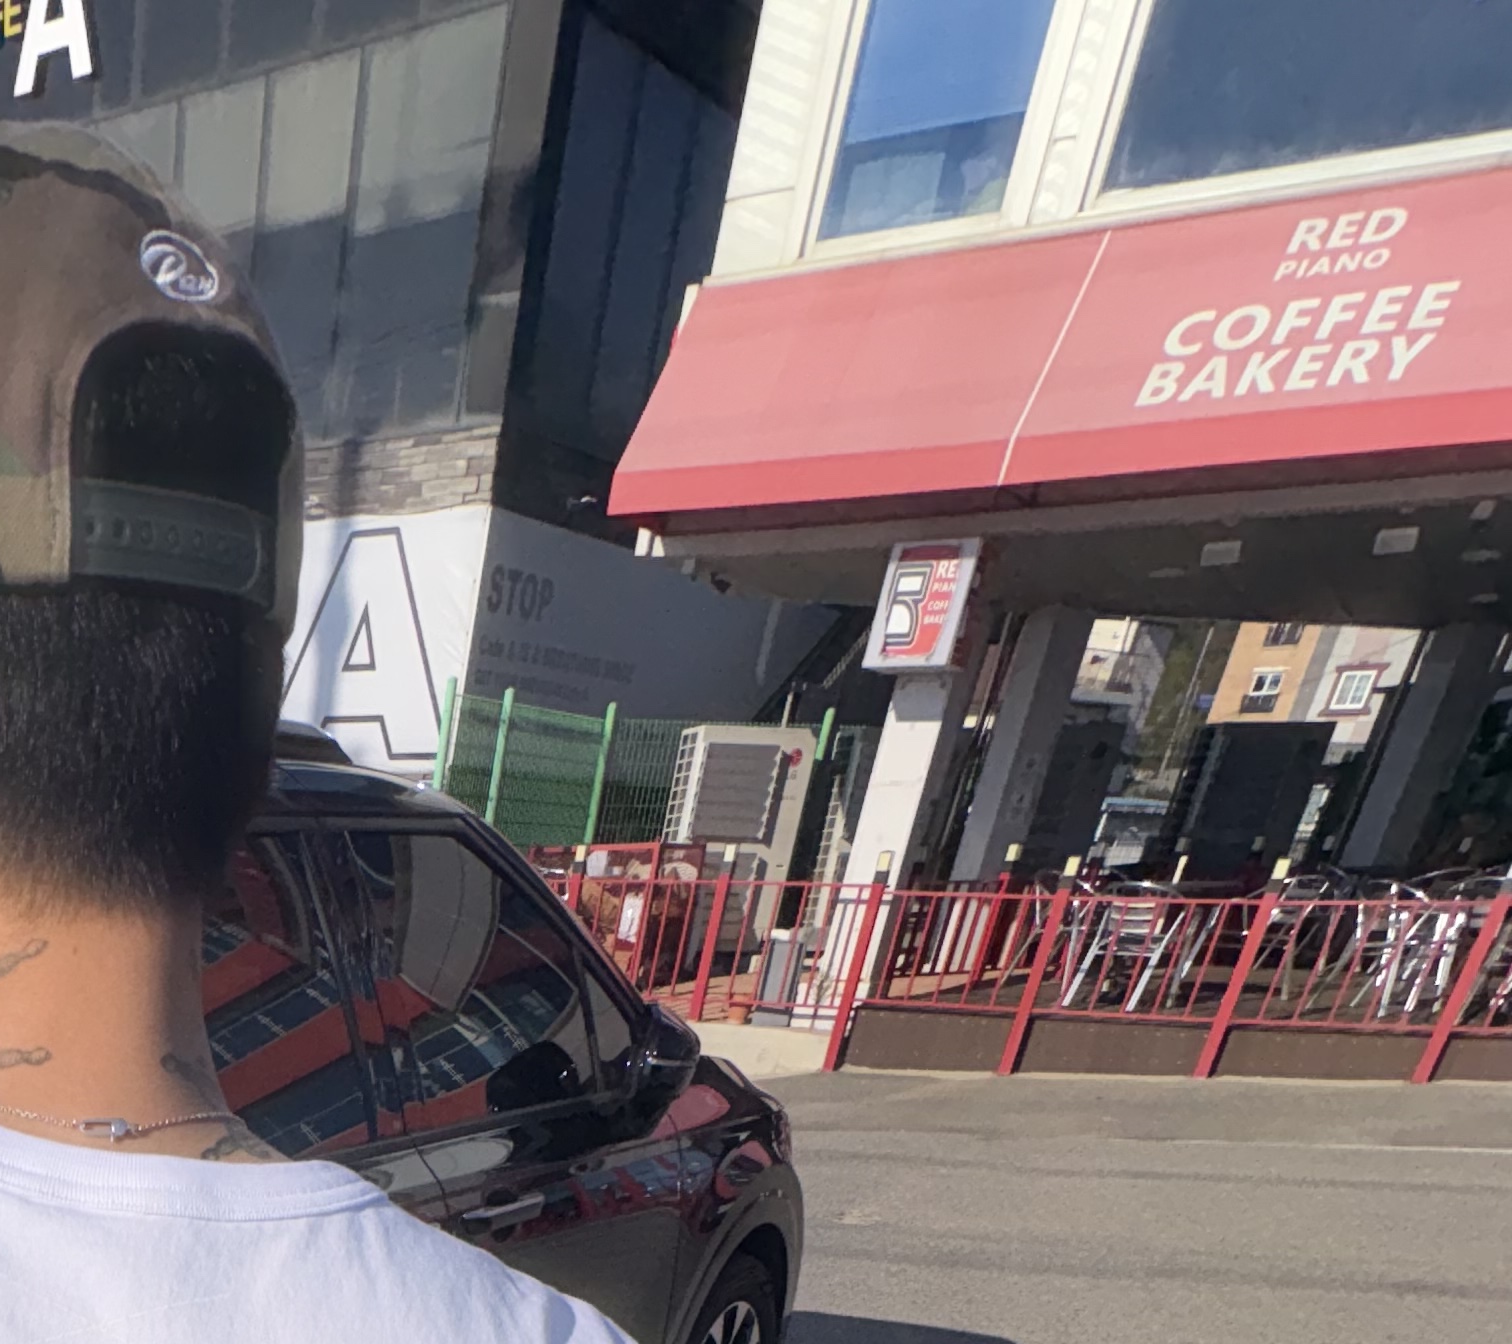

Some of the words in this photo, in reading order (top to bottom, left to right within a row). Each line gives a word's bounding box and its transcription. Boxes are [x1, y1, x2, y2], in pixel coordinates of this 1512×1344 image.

[14, 0, 92, 97] A
[1286, 207, 1408, 254] RED
[1273, 248, 1391, 282] PIANO
[1163, 280, 1462, 357] COFFEE
[1134, 332, 1437, 407] BAKERY
[487, 564, 555, 622] STOP
[932, 581, 956, 593] PIAN
[935, 560, 959, 579] RE
[279, 526, 444, 760] A
